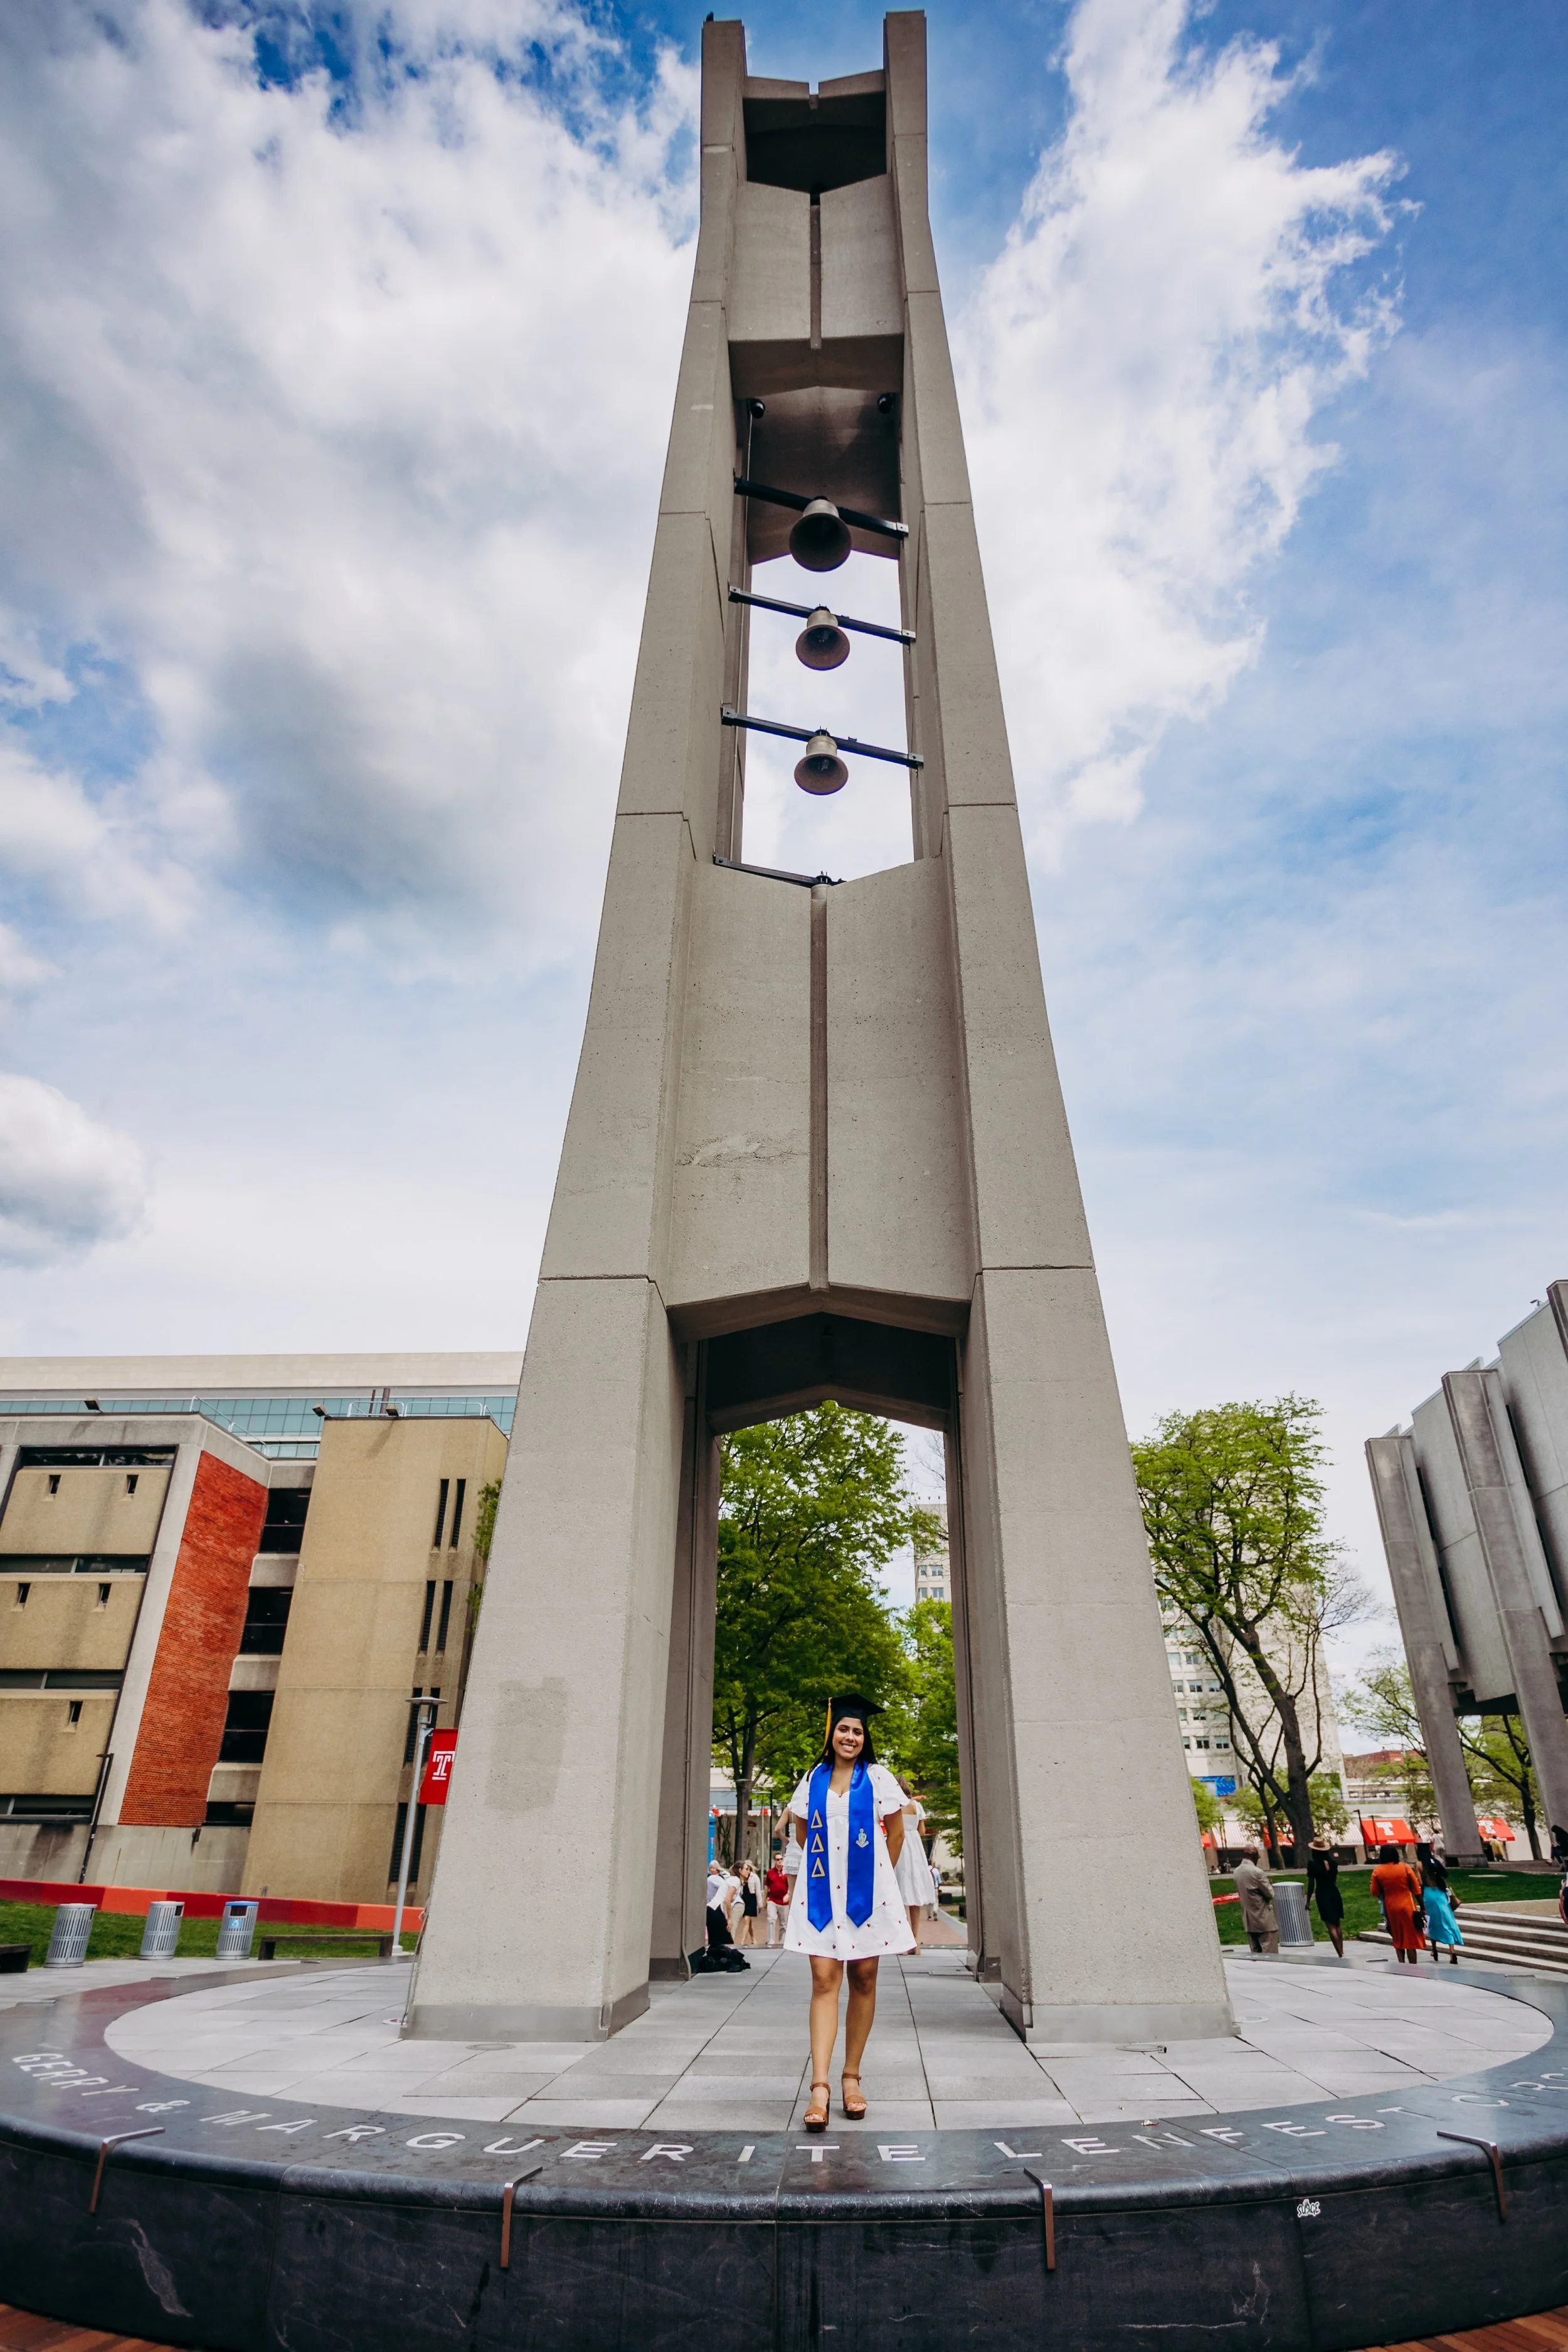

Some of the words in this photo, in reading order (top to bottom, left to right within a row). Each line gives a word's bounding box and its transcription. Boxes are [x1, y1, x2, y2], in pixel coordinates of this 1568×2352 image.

[12, 2052, 139, 2096] GERRY
[135, 2099, 191, 2113] &
[199, 2109, 926, 2162] MARGUERITE
[993, 2106, 1436, 2158] LENFEST
[1450, 2067, 1568, 2107] CIRC
